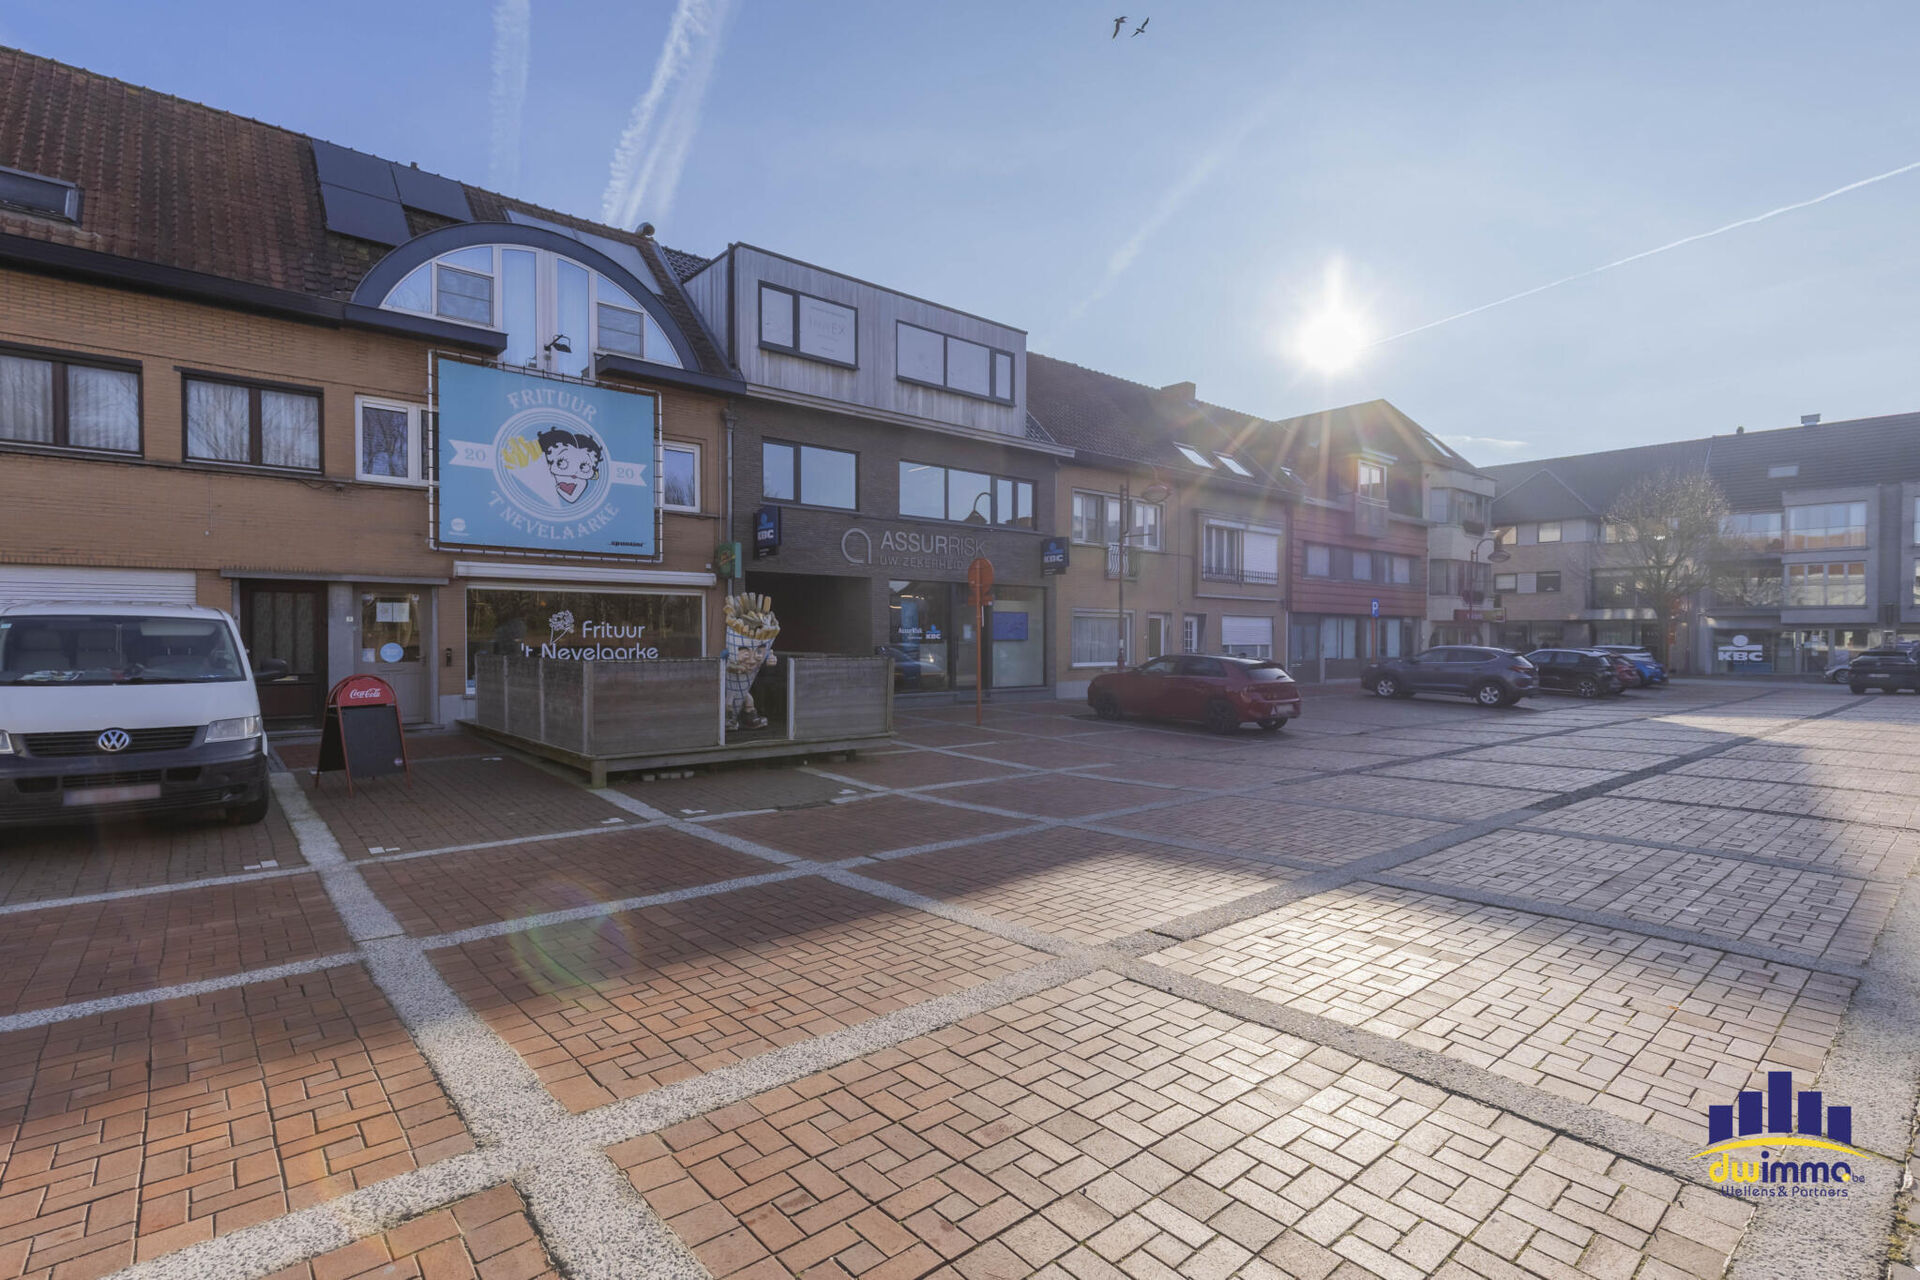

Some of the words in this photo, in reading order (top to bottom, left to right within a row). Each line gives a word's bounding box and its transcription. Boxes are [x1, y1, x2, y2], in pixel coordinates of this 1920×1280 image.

[507, 388, 598, 422] FRITUUR
[464, 448, 486, 462] 20
[616, 466, 634, 480] 20
[500, 502, 620, 540] NEVELAARKE
[757, 529, 775, 541] KBC
[880, 530, 986, 558] ASSURRISK
[1043, 554, 1064, 563] KBC
[1372, 601, 1378, 615] P
[582, 620, 645, 639] Frituur
[925, 632, 942, 640] KBC
[541, 642, 659, 660] Nevelaarke
[1717, 651, 1763, 662] KBC
